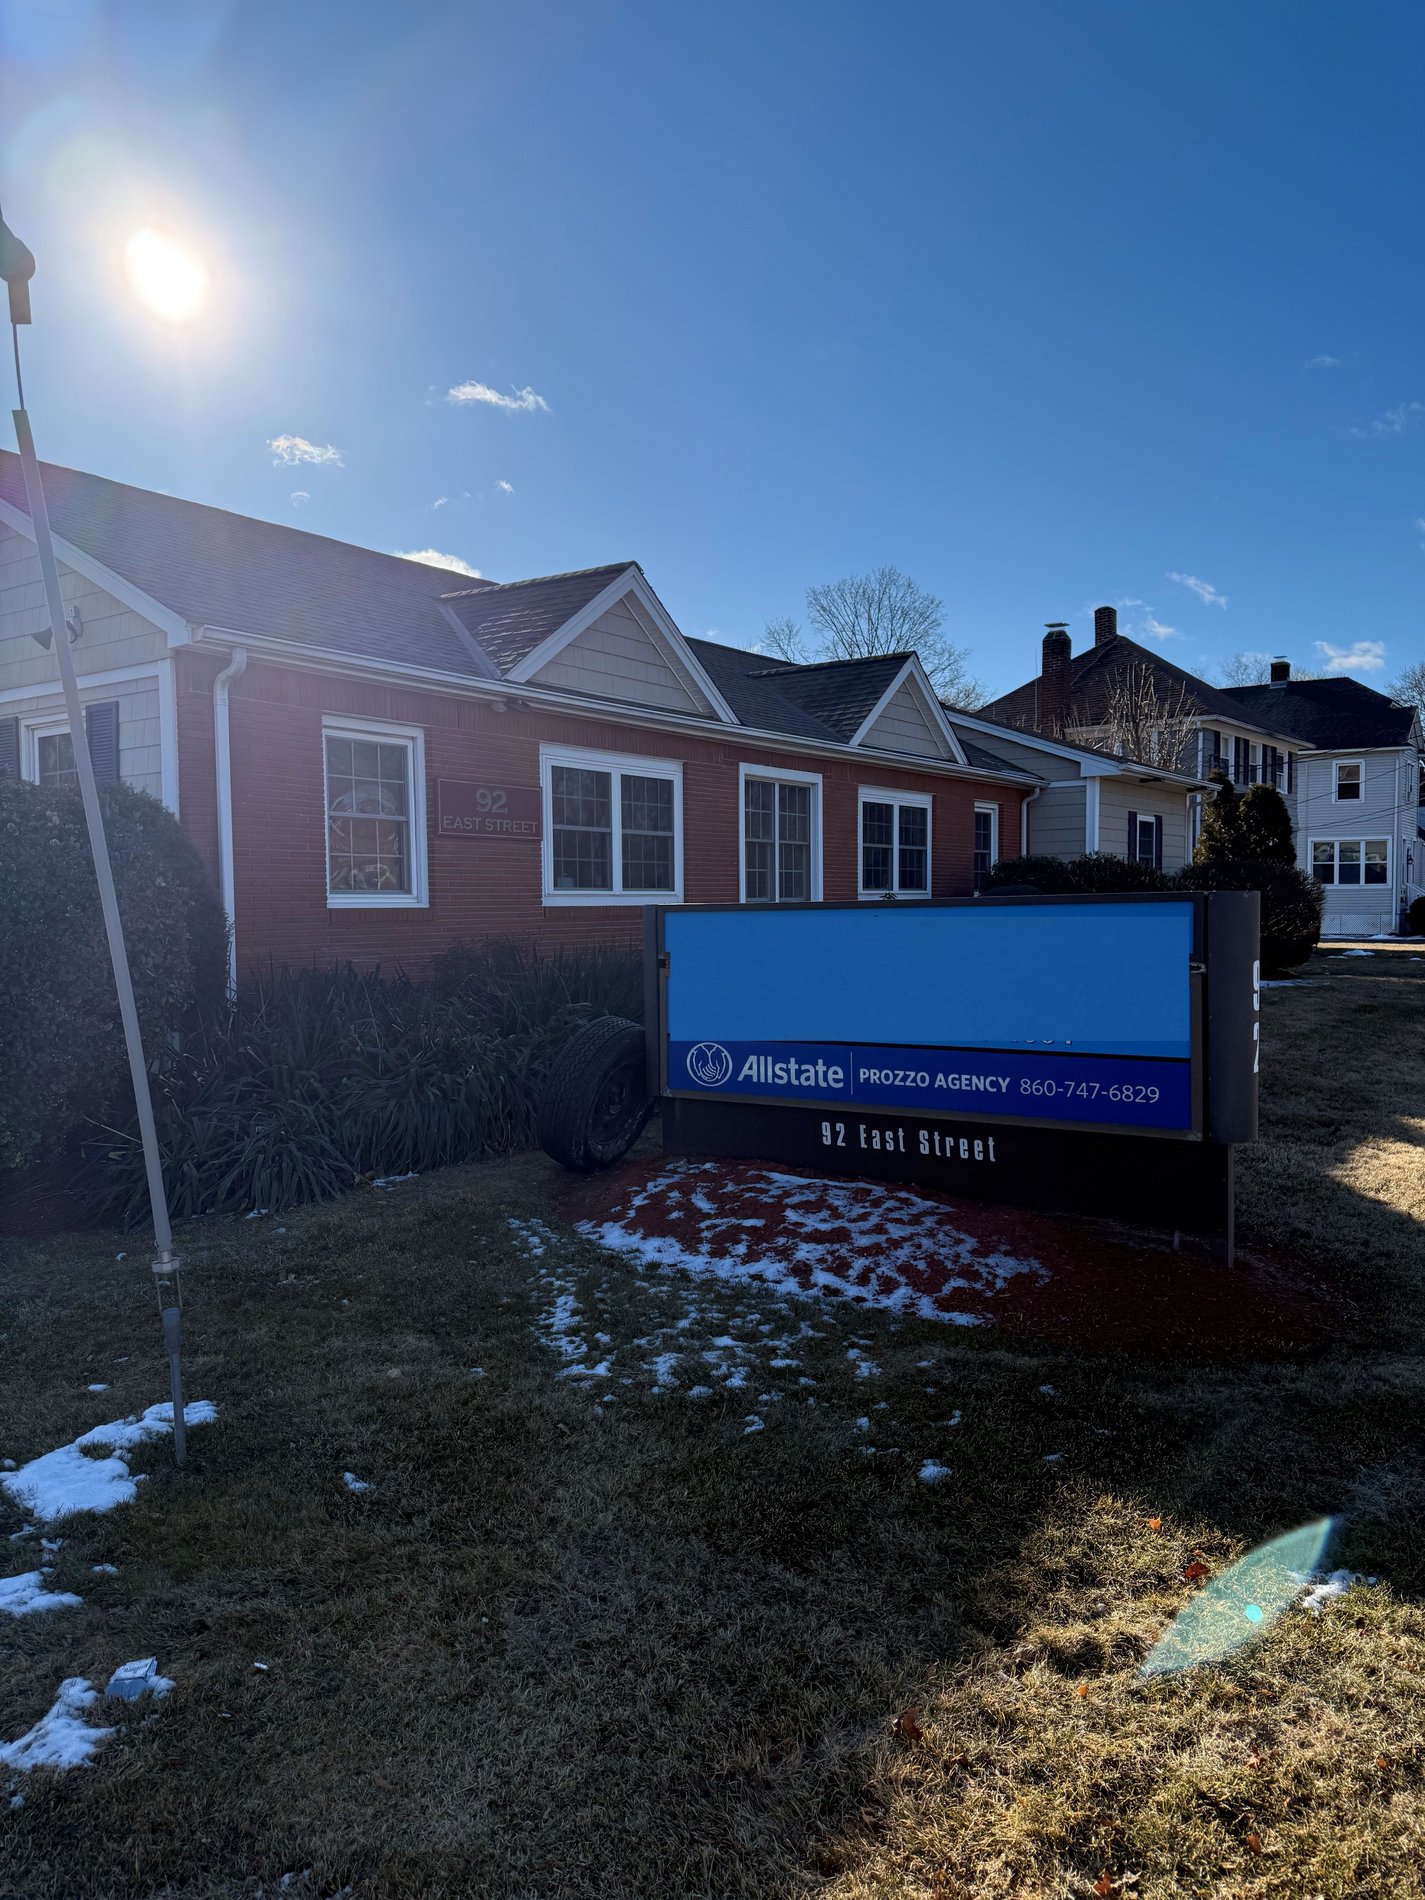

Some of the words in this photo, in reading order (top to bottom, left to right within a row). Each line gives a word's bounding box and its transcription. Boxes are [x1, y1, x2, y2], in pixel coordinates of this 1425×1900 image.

[475, 788, 508, 814] 92
[443, 815, 482, 831] EAST
[485, 818, 539, 834] STREET
[737, 1055, 844, 1089] Allstate
[859, 1068, 930, 1087] PROZZO
[934, 1073, 1011, 1093] AGENCY
[1020, 1078, 1160, 1104] 860-747-6829
[821, 1121, 846, 1147] 92
[859, 1124, 905, 1152] East
[919, 1129, 996, 1162] Street
